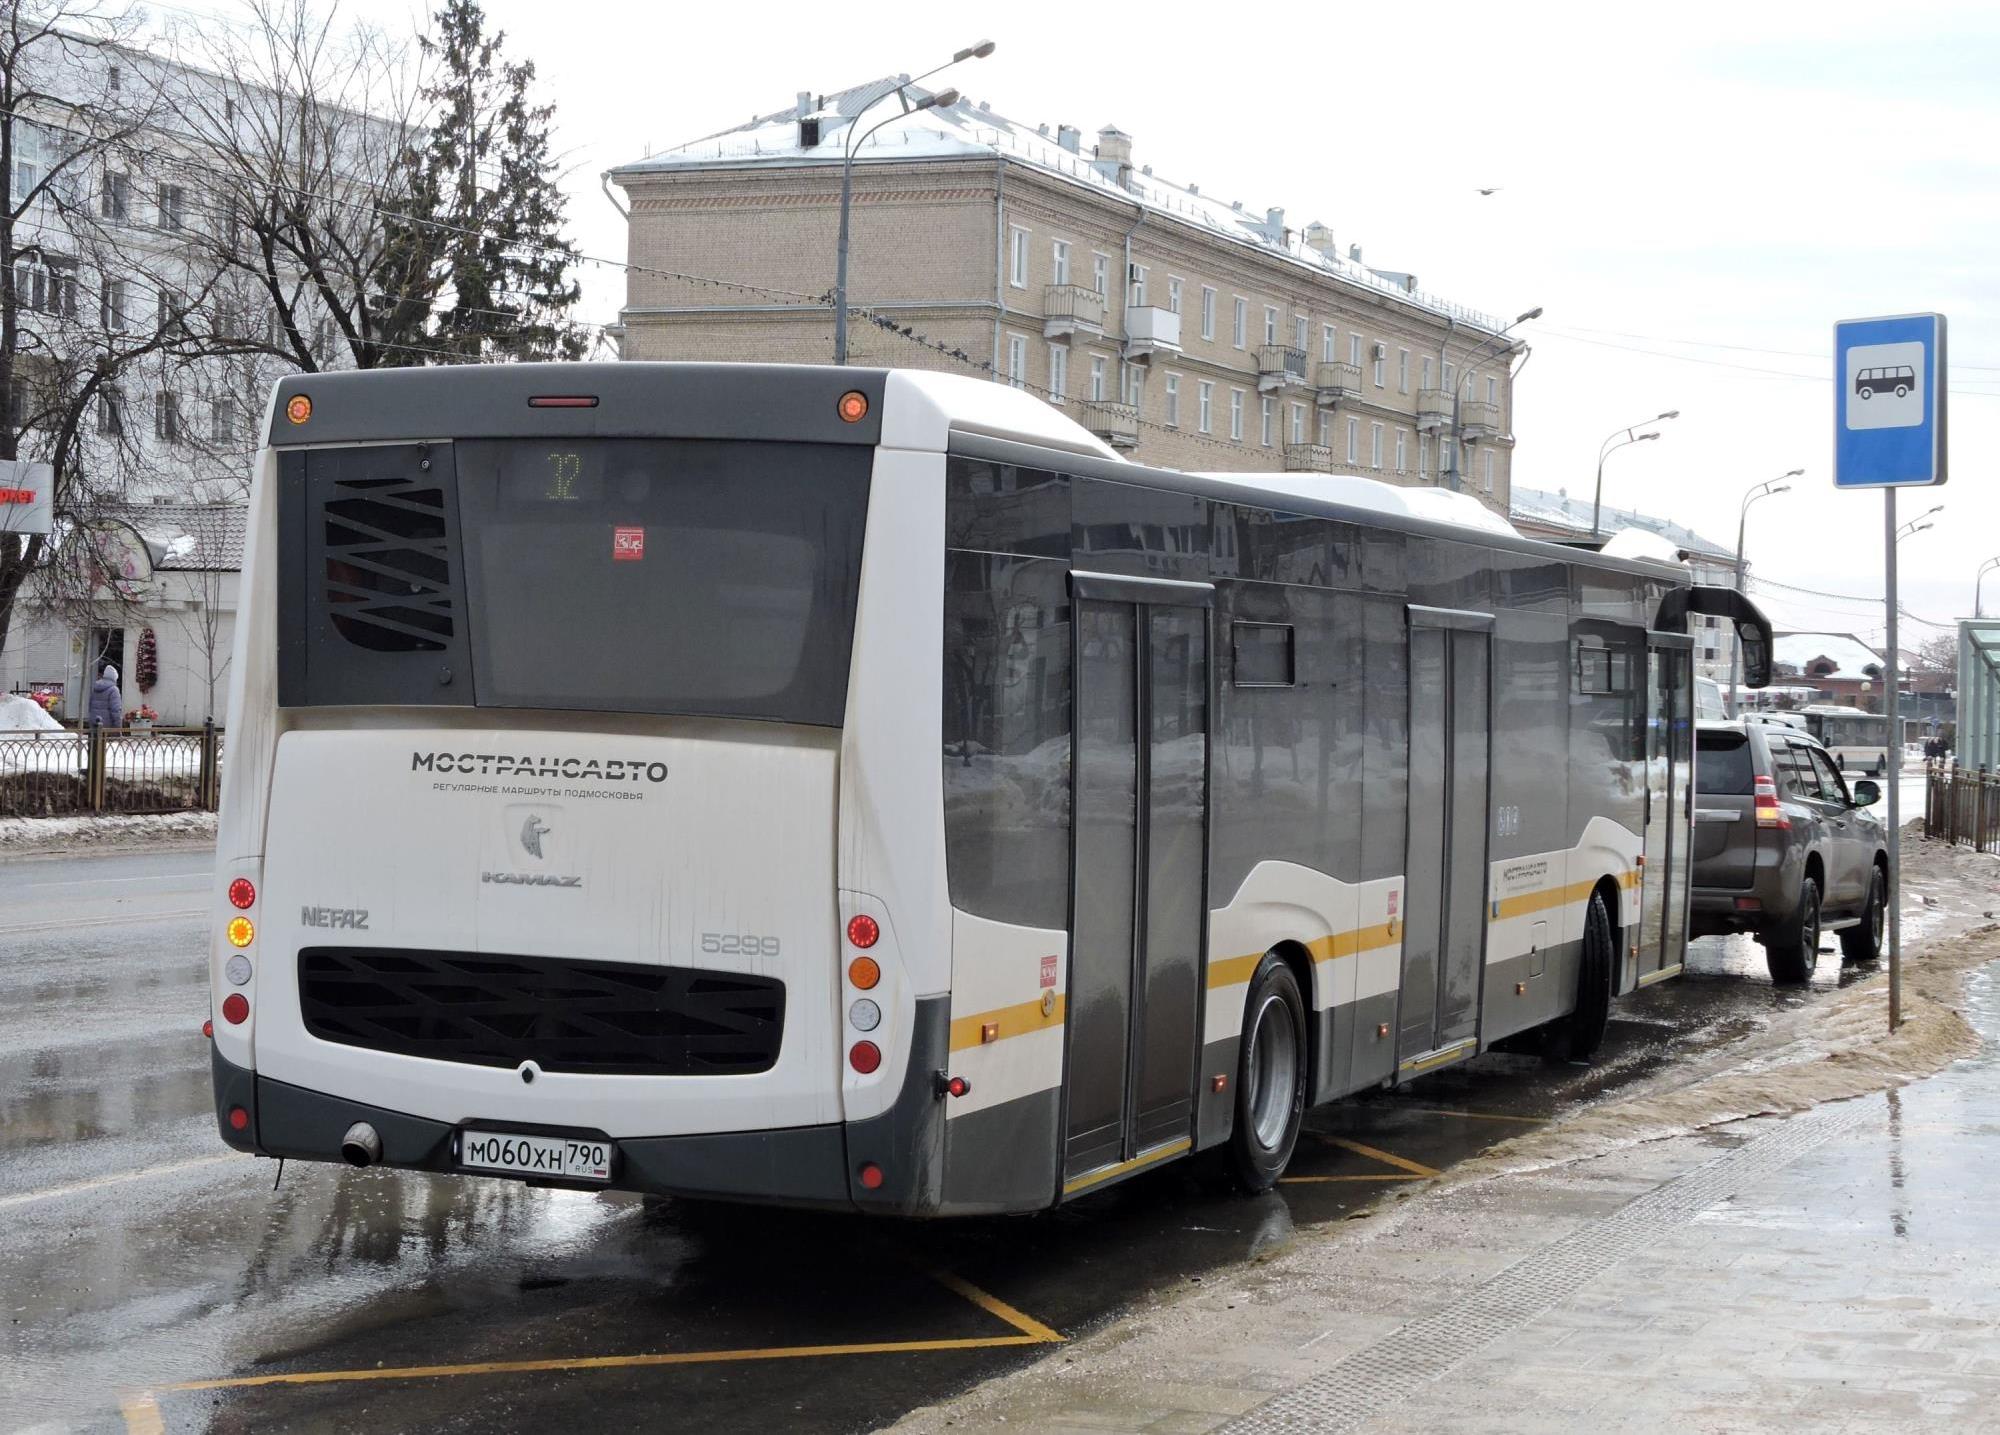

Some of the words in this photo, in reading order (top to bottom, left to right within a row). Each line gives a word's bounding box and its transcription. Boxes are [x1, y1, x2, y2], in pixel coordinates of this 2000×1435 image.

[411, 751, 669, 783] МОСТРАНСАВТО
[432, 782, 499, 795] РЕГУЛЯРНЫЕ
[501, 786, 562, 798] МАРШРУТЫ
[564, 789, 644, 801] ПОДМОСКОВЬЯ
[481, 871, 582, 888] KAMAZ
[301, 905, 369, 930] NEFAZ
[701, 932, 781, 957] 5299
[567, 1143, 604, 1166] 790
[575, 1164, 593, 1174] RUS
